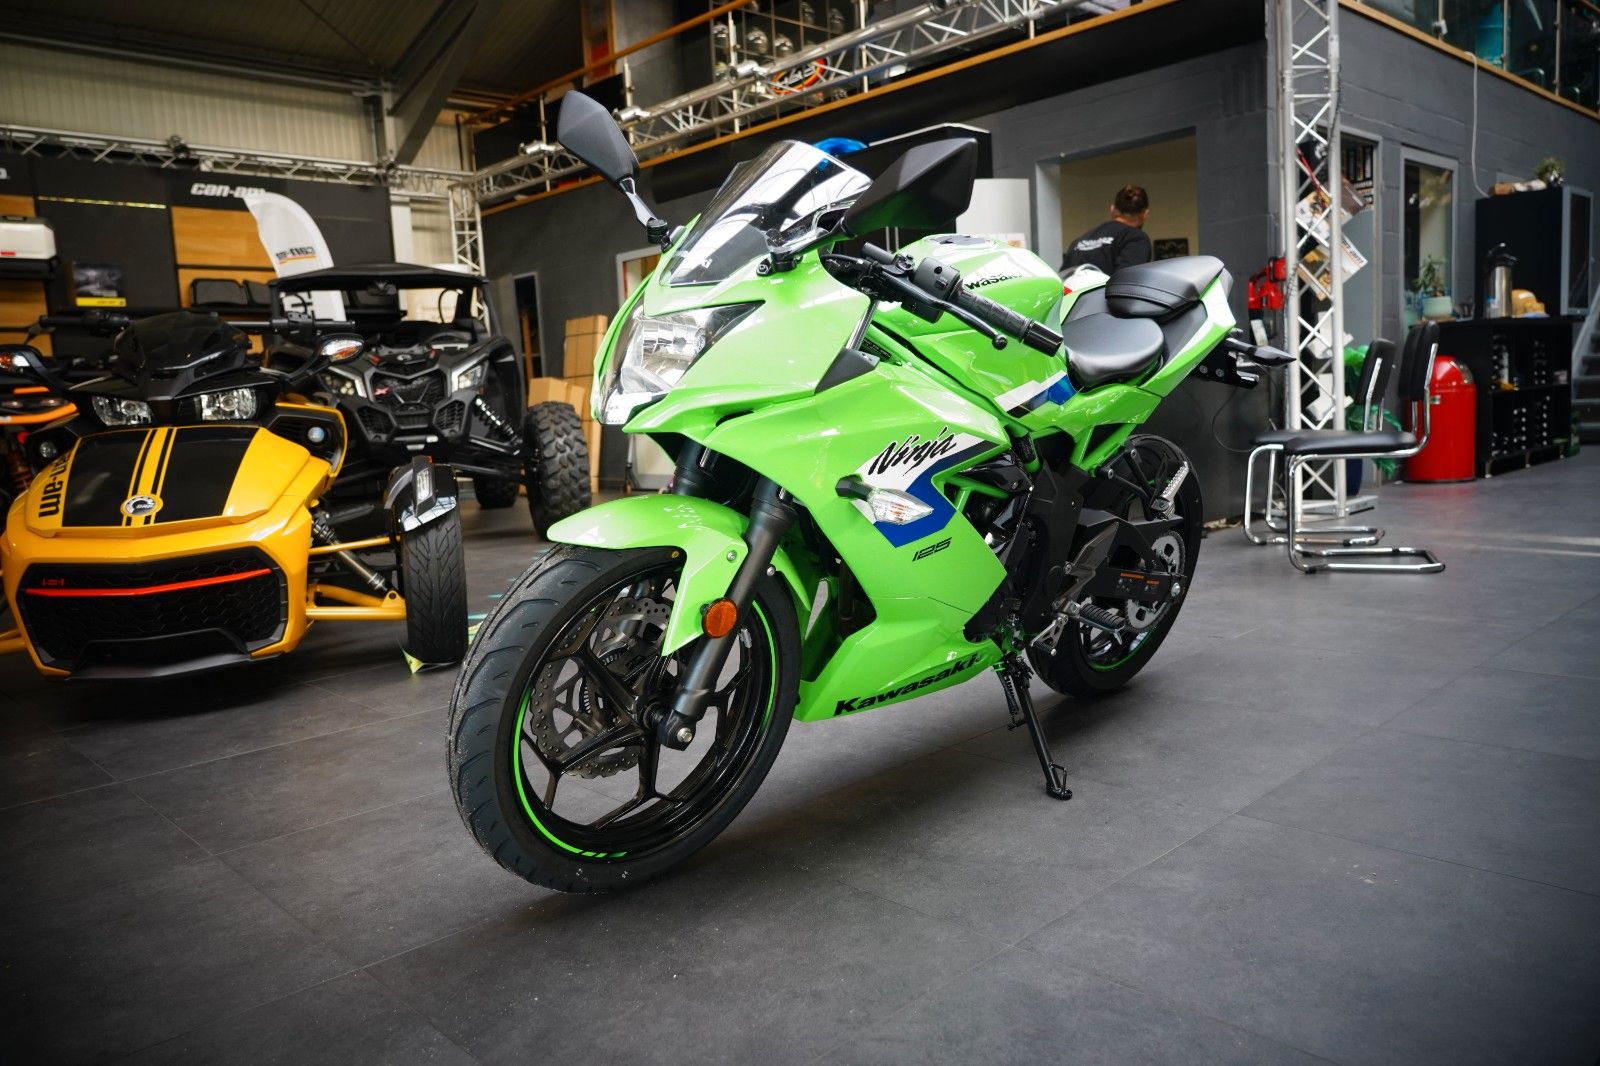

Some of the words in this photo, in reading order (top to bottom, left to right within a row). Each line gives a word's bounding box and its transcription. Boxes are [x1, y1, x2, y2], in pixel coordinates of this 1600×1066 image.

[867, 426, 957, 476] Ninja
[912, 537, 952, 561] 125
[834, 652, 978, 716] Kawasaki
